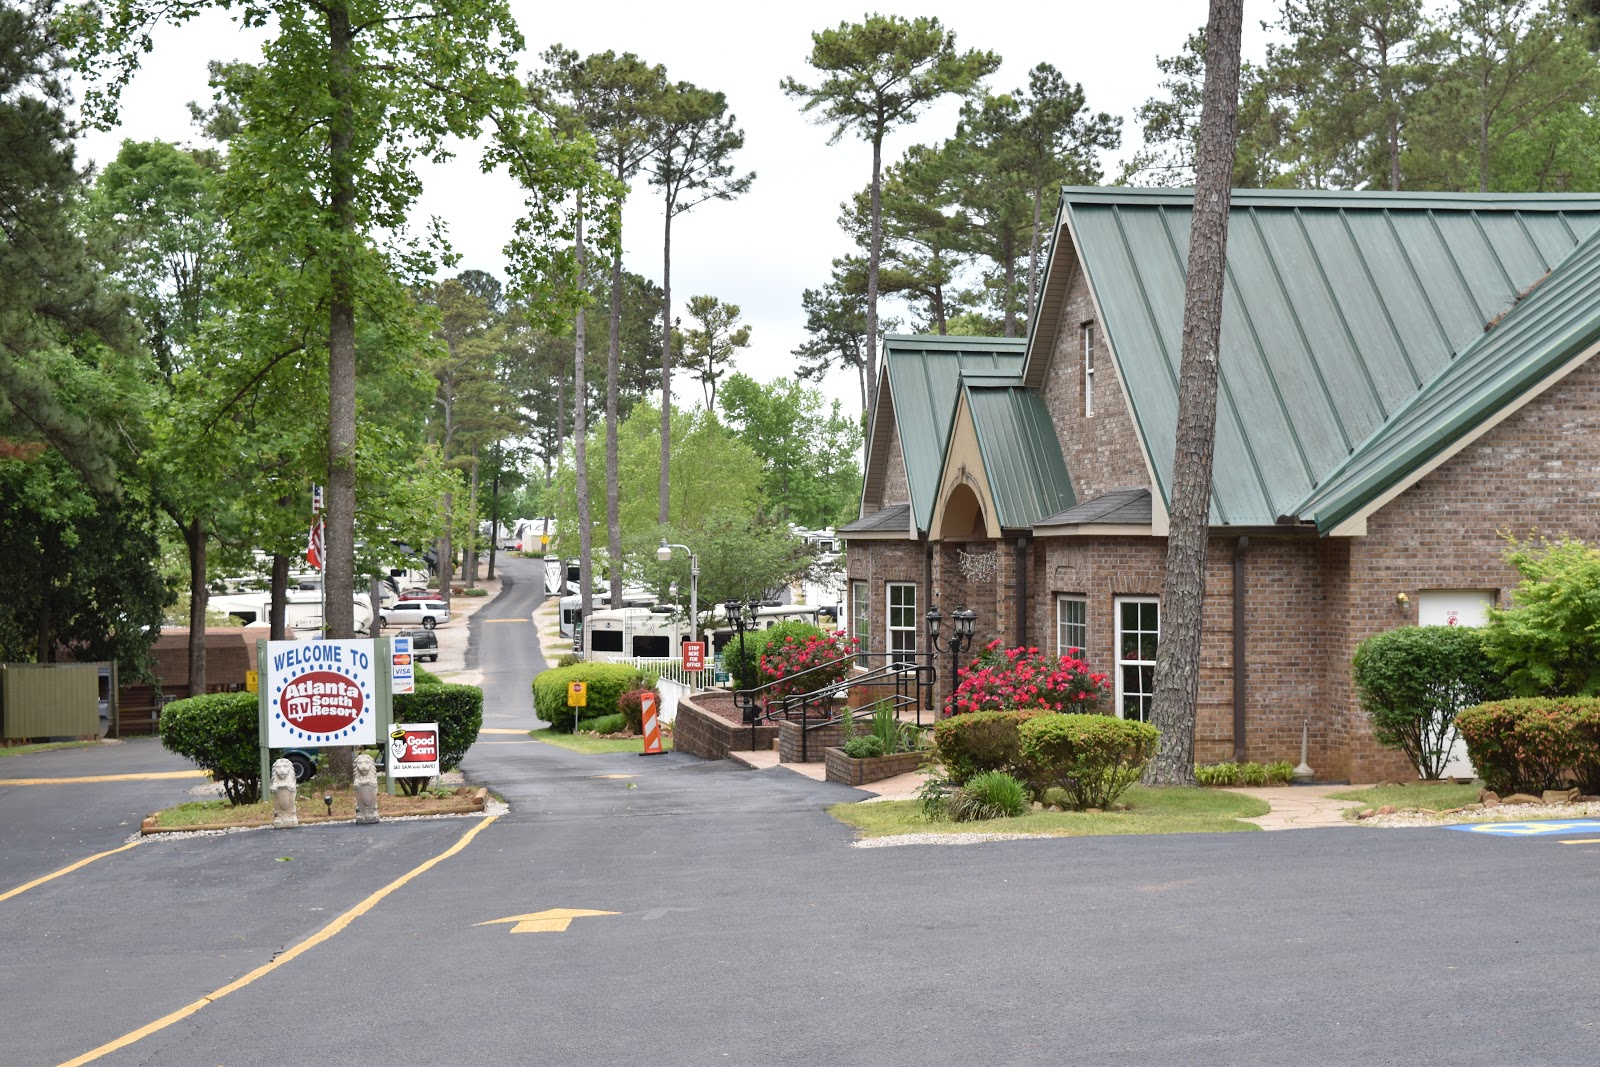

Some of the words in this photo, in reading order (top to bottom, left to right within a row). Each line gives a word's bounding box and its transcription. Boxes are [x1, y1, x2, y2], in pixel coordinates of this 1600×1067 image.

[274, 645, 341, 671] WELCOME
[350, 649, 368, 670] TO
[285, 680, 359, 699] Atlanta
[312, 695, 352, 707] South
[289, 701, 309, 715] RV
[312, 705, 357, 718] Resort
[407, 735, 435, 745] Good
[411, 745, 435, 755] Sam
